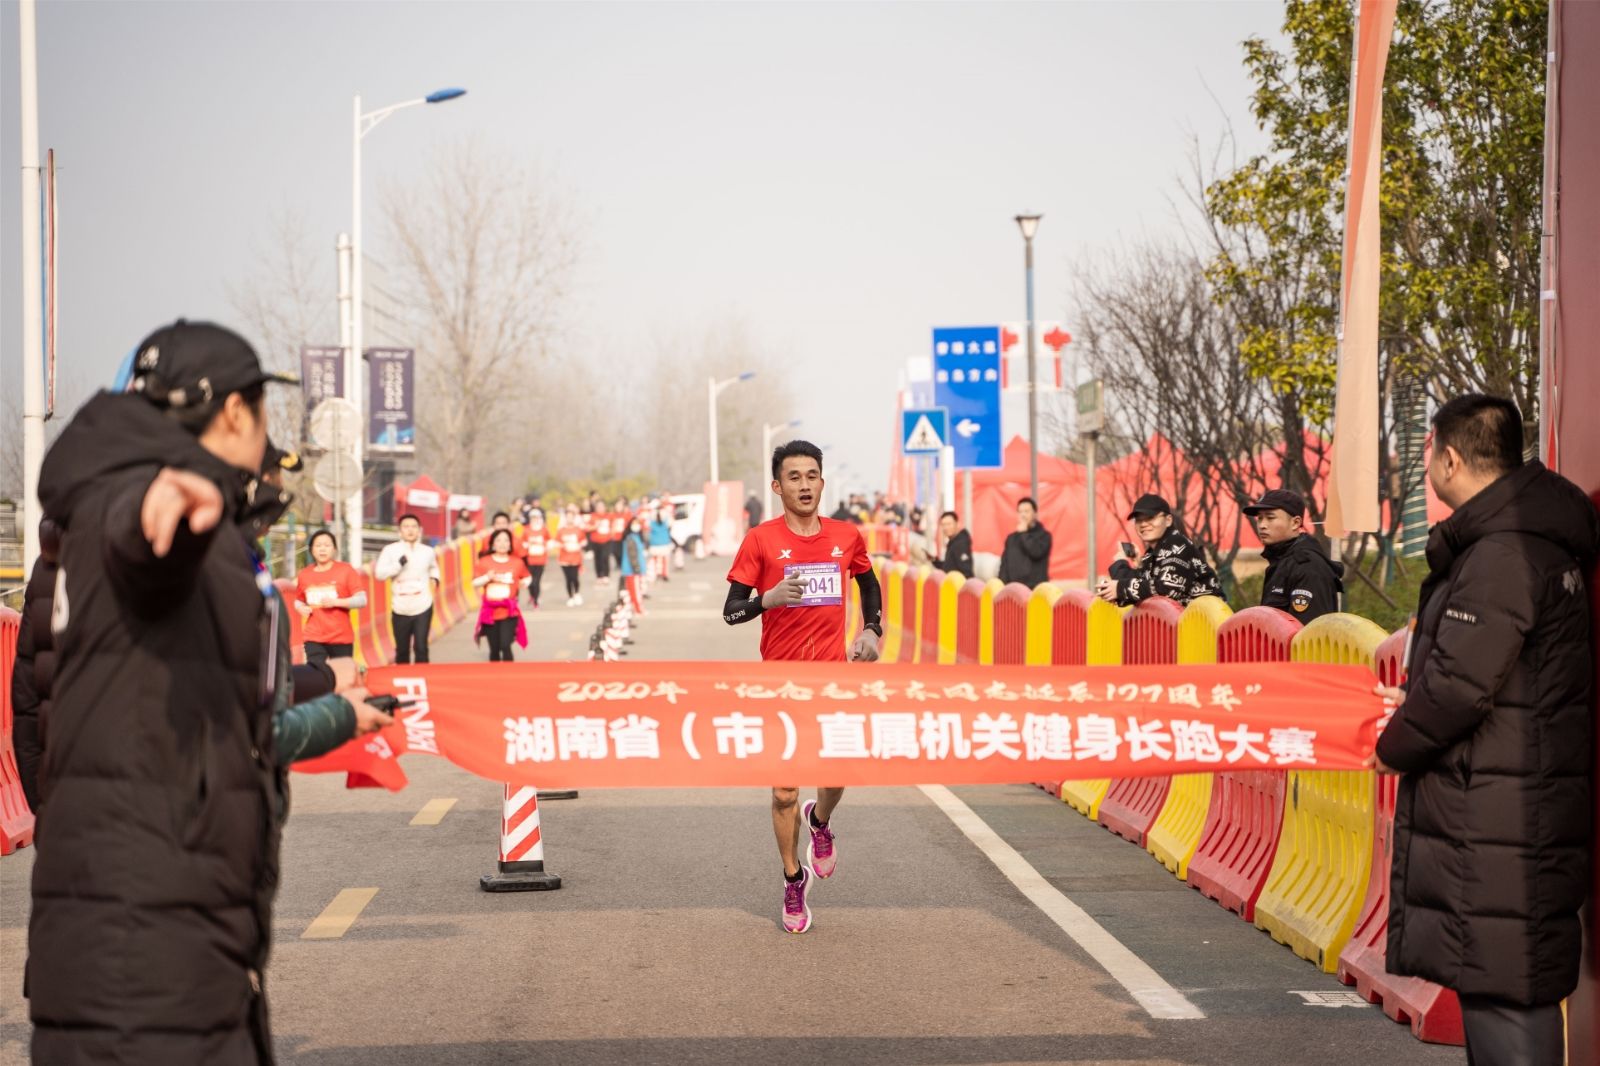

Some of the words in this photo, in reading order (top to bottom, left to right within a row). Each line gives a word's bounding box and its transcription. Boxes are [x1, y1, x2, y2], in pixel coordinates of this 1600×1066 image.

[503, 711, 1318, 765] 湖南省（市）直属机关健身长跑大赛
